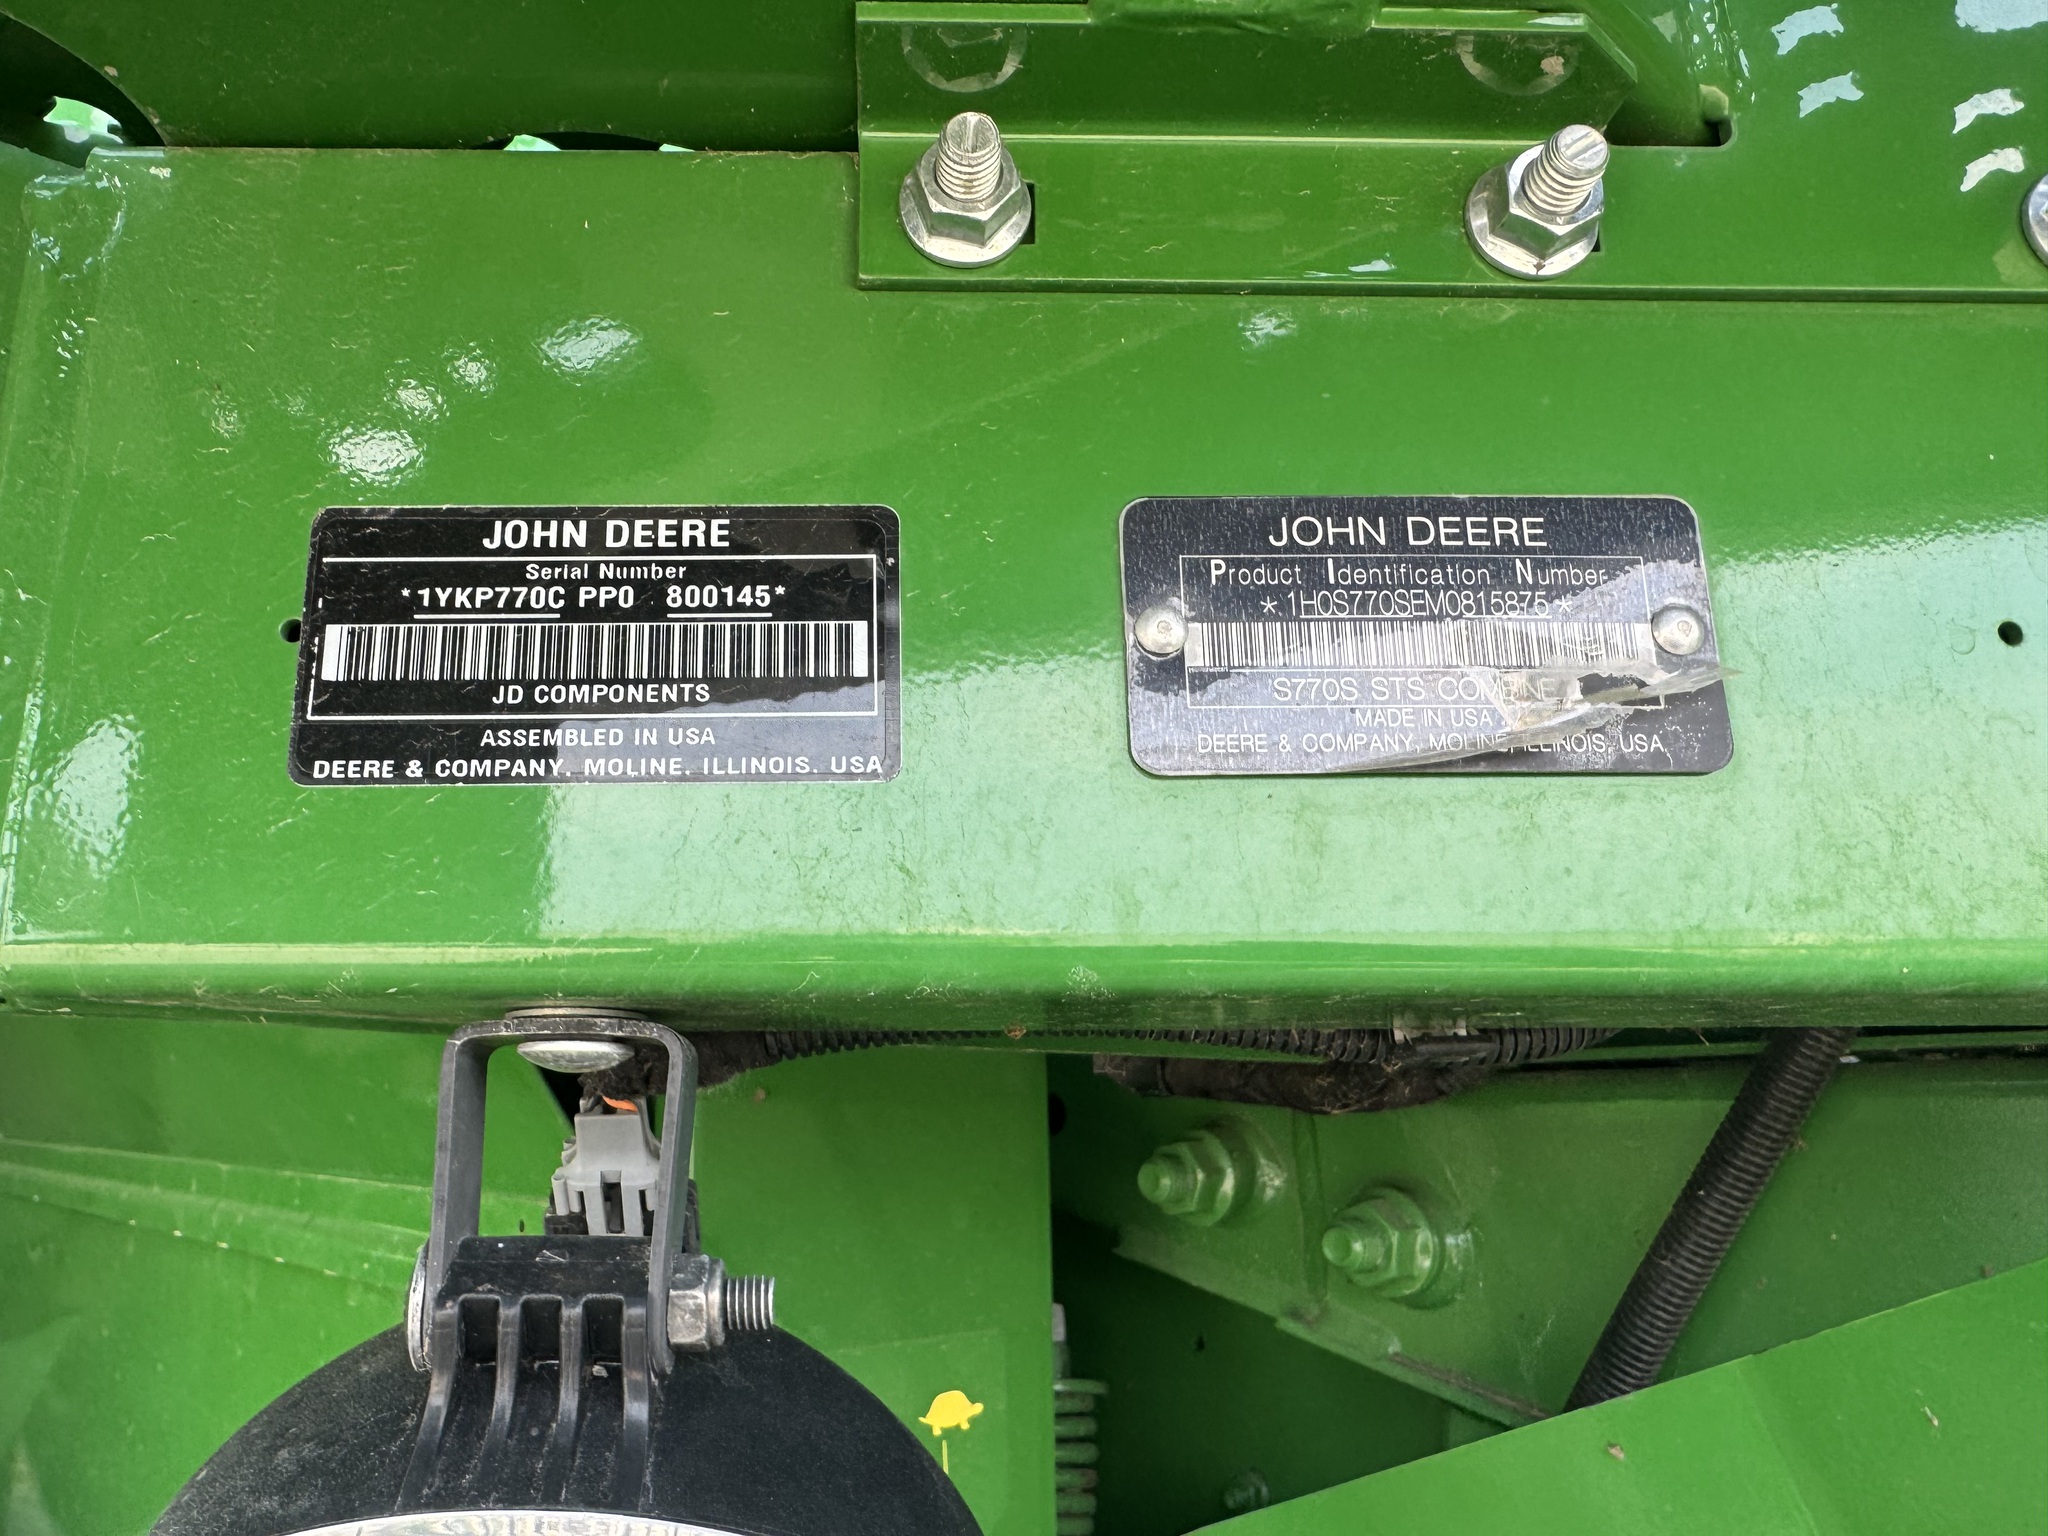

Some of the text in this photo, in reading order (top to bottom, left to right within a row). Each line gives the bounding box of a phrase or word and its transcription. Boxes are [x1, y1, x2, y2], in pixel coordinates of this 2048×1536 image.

[482, 518, 731, 550] JOHN DEERE
[1268, 517, 1548, 547] JOHN DEERE
[525, 562, 687, 580] Serial Number
[1210, 557, 1608, 586] Product Identification Number
[492, 684, 711, 704] JD COMPONENTS
[1273, 677, 1359, 701] S770S
[1371, 676, 1426, 701] STS
[1354, 708, 1493, 727] MADE IN USA
[480, 727, 716, 747] ASSEMBLED IN USA
[1197, 733, 1269, 753] DEERE
[1278, 733, 1293, 752] &
[1302, 732, 1421, 754] COMPANY,
[1619, 733, 1666, 753] USA
[313, 759, 395, 779] DEERE
[405, 759, 424, 778] &
[830, 754, 884, 774] USA
